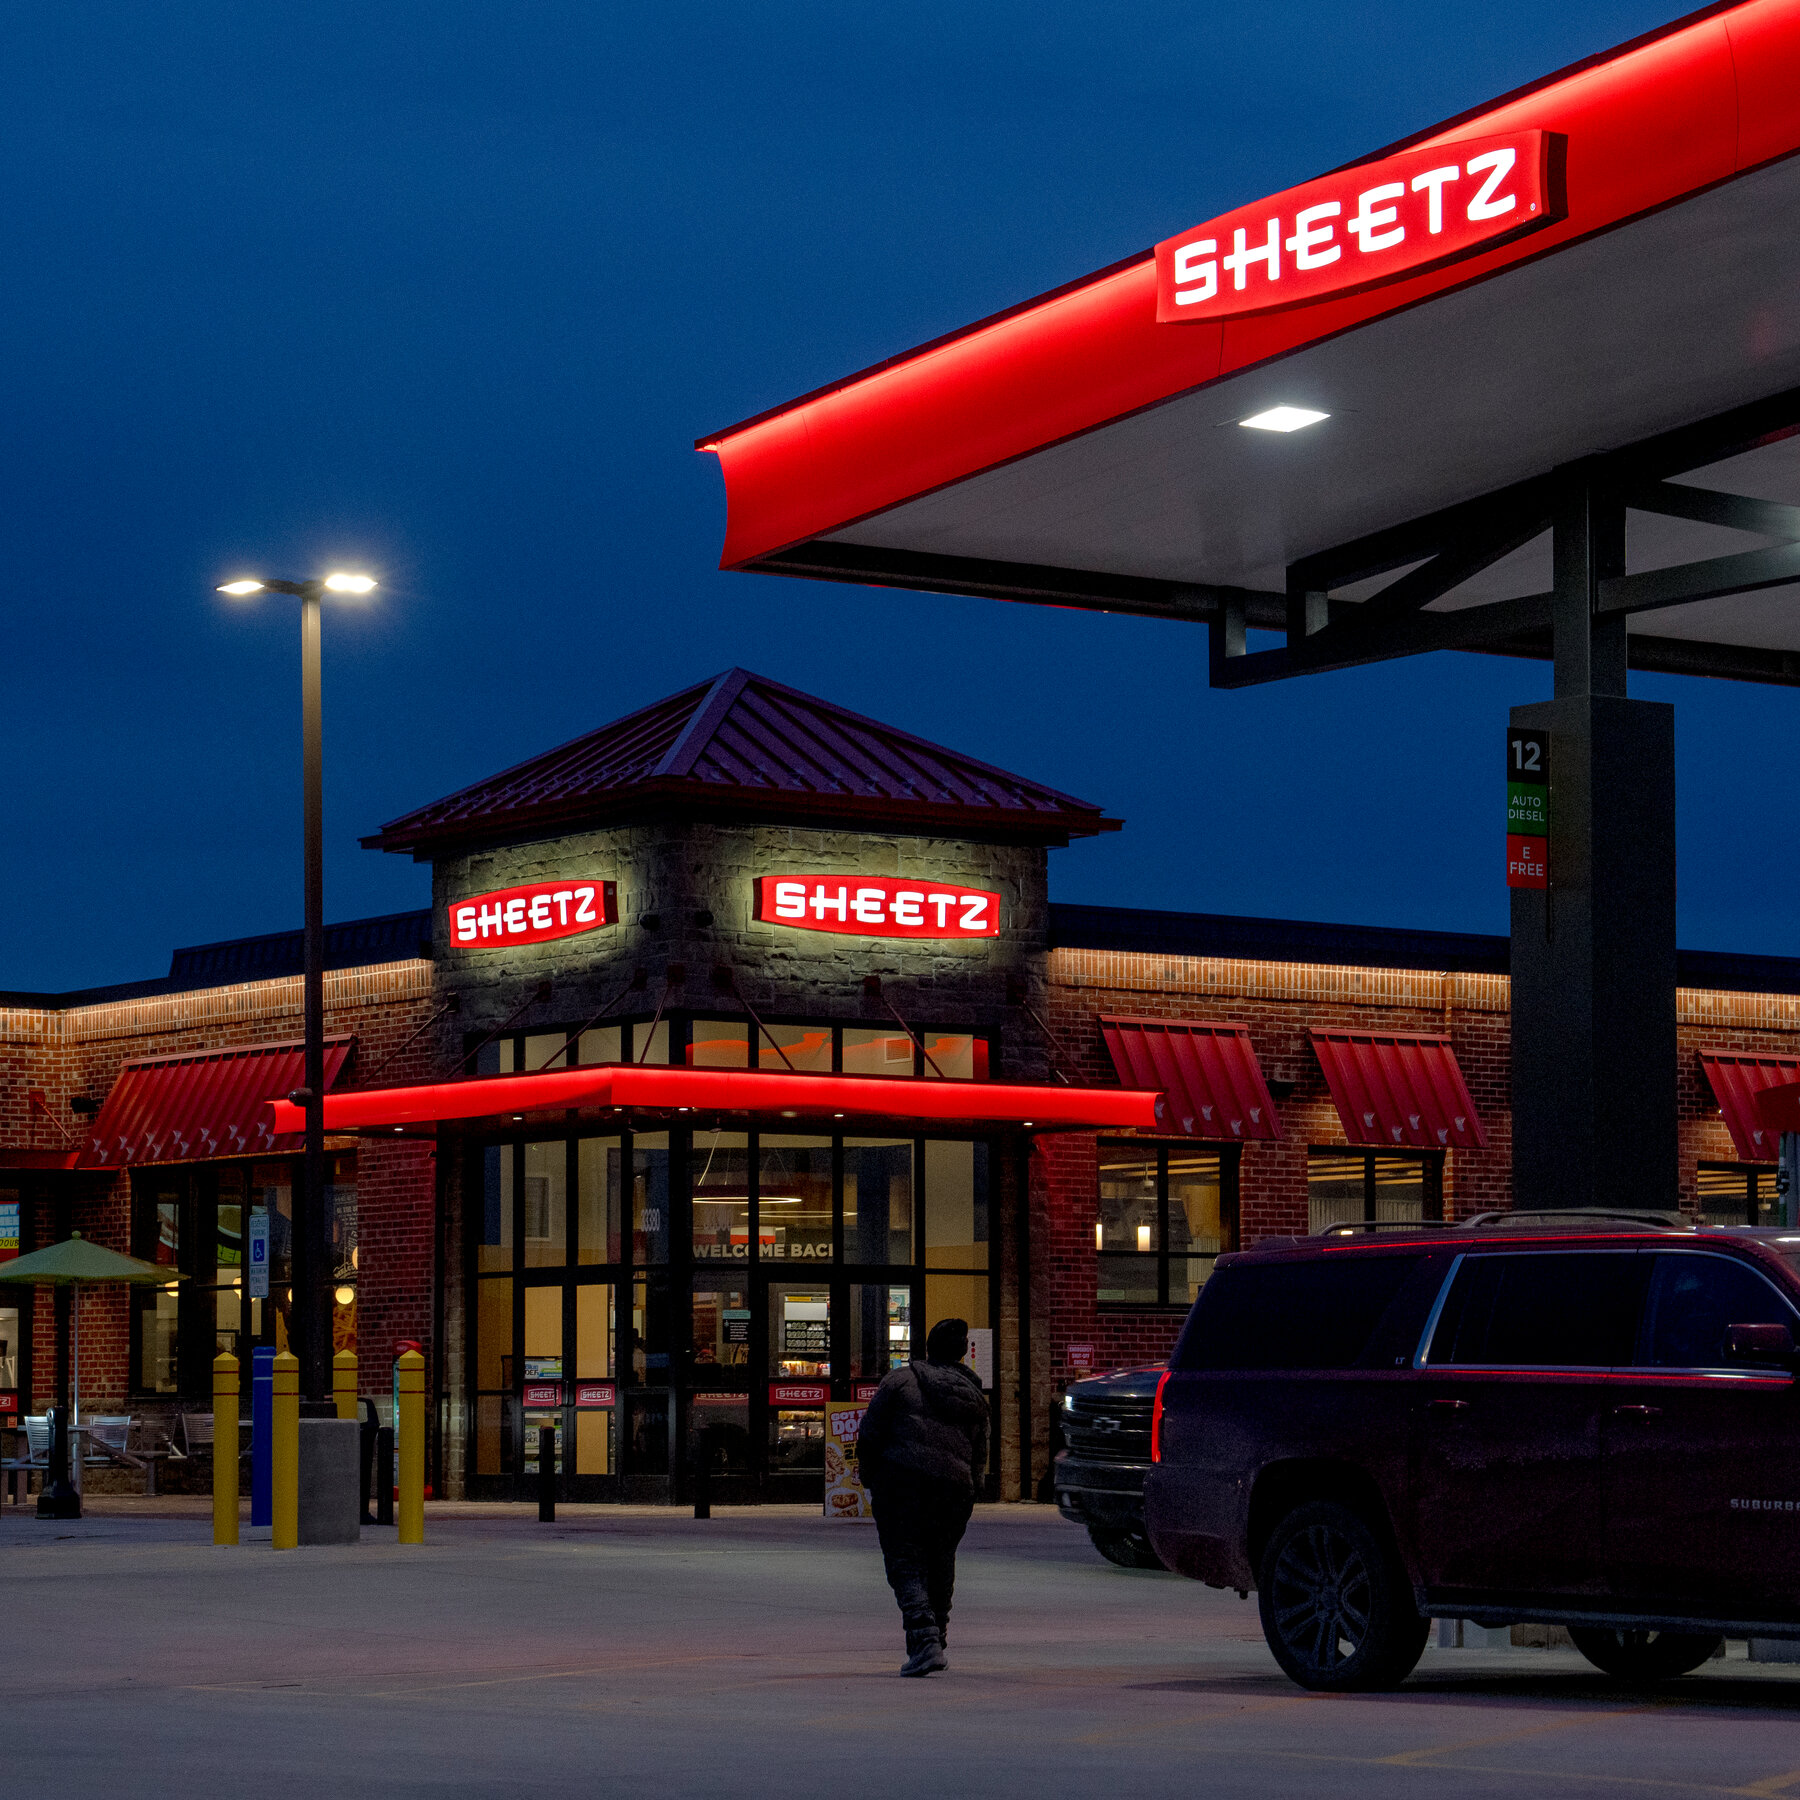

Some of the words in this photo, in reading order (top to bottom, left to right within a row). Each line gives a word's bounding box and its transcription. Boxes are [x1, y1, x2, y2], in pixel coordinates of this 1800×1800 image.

[1175, 148, 1516, 306] SHEETZ
[1512, 740, 1541, 771] 12
[1511, 795, 1541, 807] AUTO
[1508, 809, 1544, 822] DIESEL
[1522, 846, 1531, 859] E
[1509, 862, 1544, 876] FREE
[776, 882, 988, 930] SHEETZ
[457, 887, 596, 941] SHEETZ
[693, 1243, 785, 1258] WELCME
[582, 1391, 609, 1399] SHEETZ
[779, 1390, 821, 1398] SHEETZ
[831, 1411, 855, 1421] GOT
[832, 1419, 860, 1435] DO
